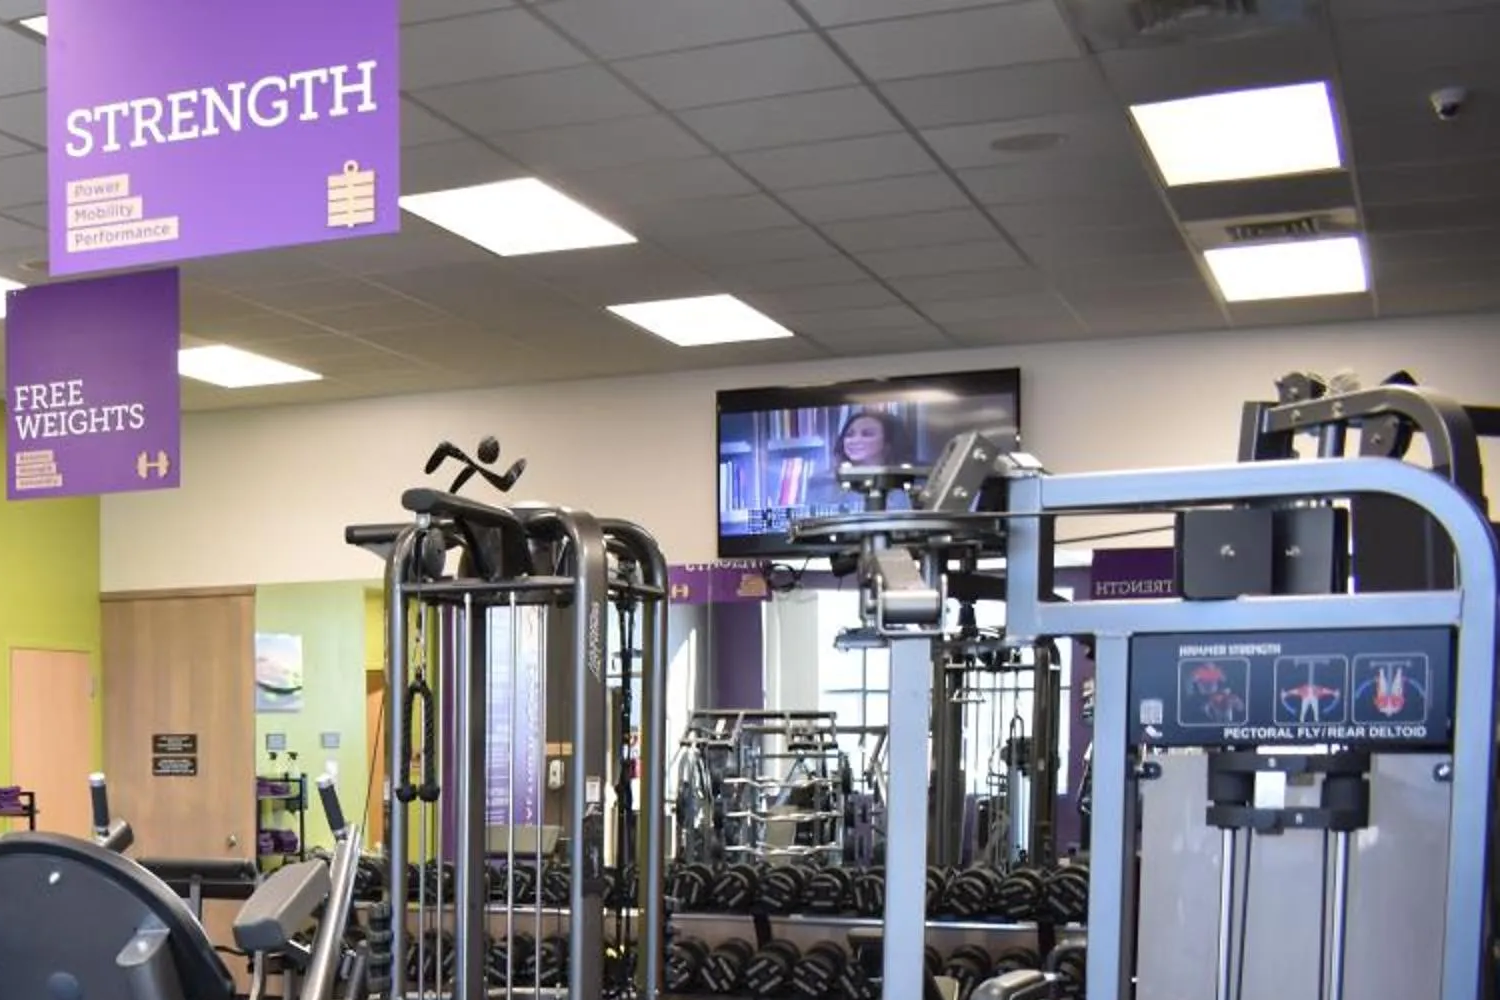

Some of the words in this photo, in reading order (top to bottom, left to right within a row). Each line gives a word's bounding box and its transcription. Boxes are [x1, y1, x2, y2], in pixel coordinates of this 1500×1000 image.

[65, 60, 376, 157] STRENGTH
[74, 180, 121, 198] Power
[74, 201, 135, 223] Mobility
[74, 222, 171, 247] Performance
[13, 379, 84, 412] FREE
[15, 403, 145, 440] WEIGHTS
[1228, 643, 1282, 655] STRENGTH
[1223, 727, 1294, 739] PECTORAL
[1369, 726, 1427, 738] DELTOID
